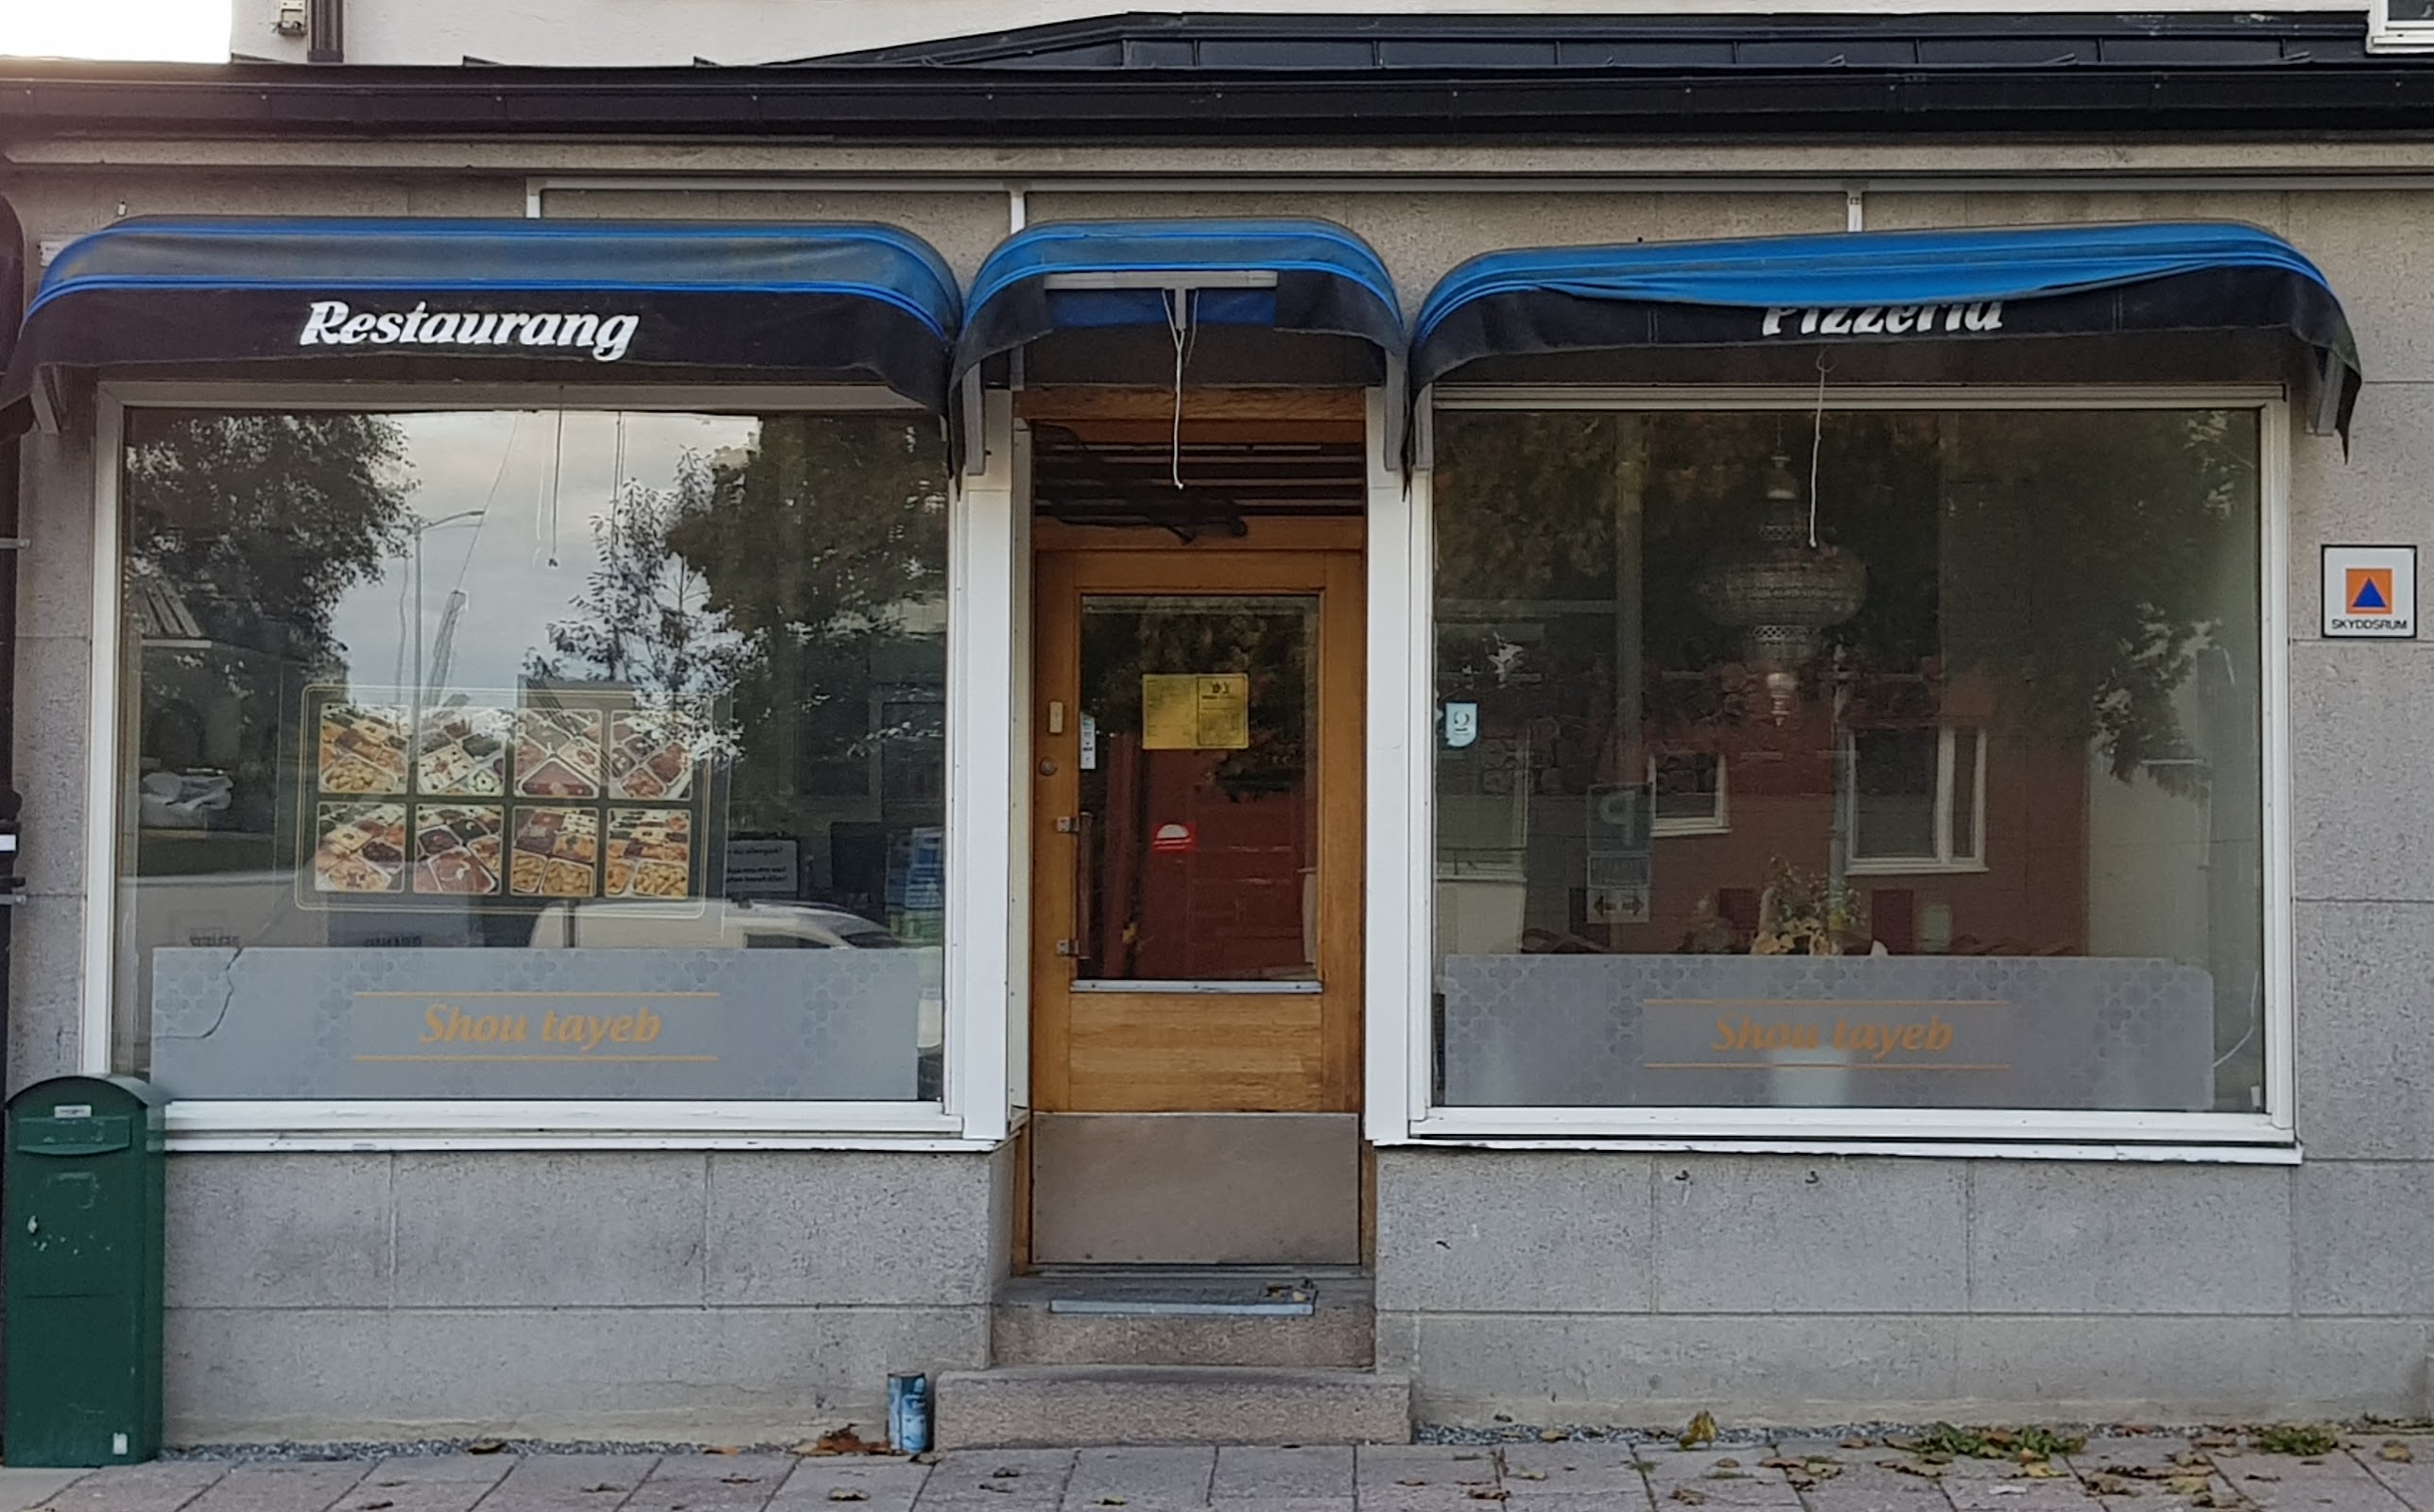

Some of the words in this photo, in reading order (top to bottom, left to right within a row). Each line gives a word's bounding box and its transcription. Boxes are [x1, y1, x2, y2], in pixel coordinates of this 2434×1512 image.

[299, 300, 640, 362] Restaurang
[2331, 618, 2408, 630] SKYDDSRUM
[418, 1003, 529, 1045] Shou
[541, 1005, 662, 1053] tayeb
[1709, 1013, 1821, 1053] Shou
[1831, 1013, 1954, 1059] tayeb
